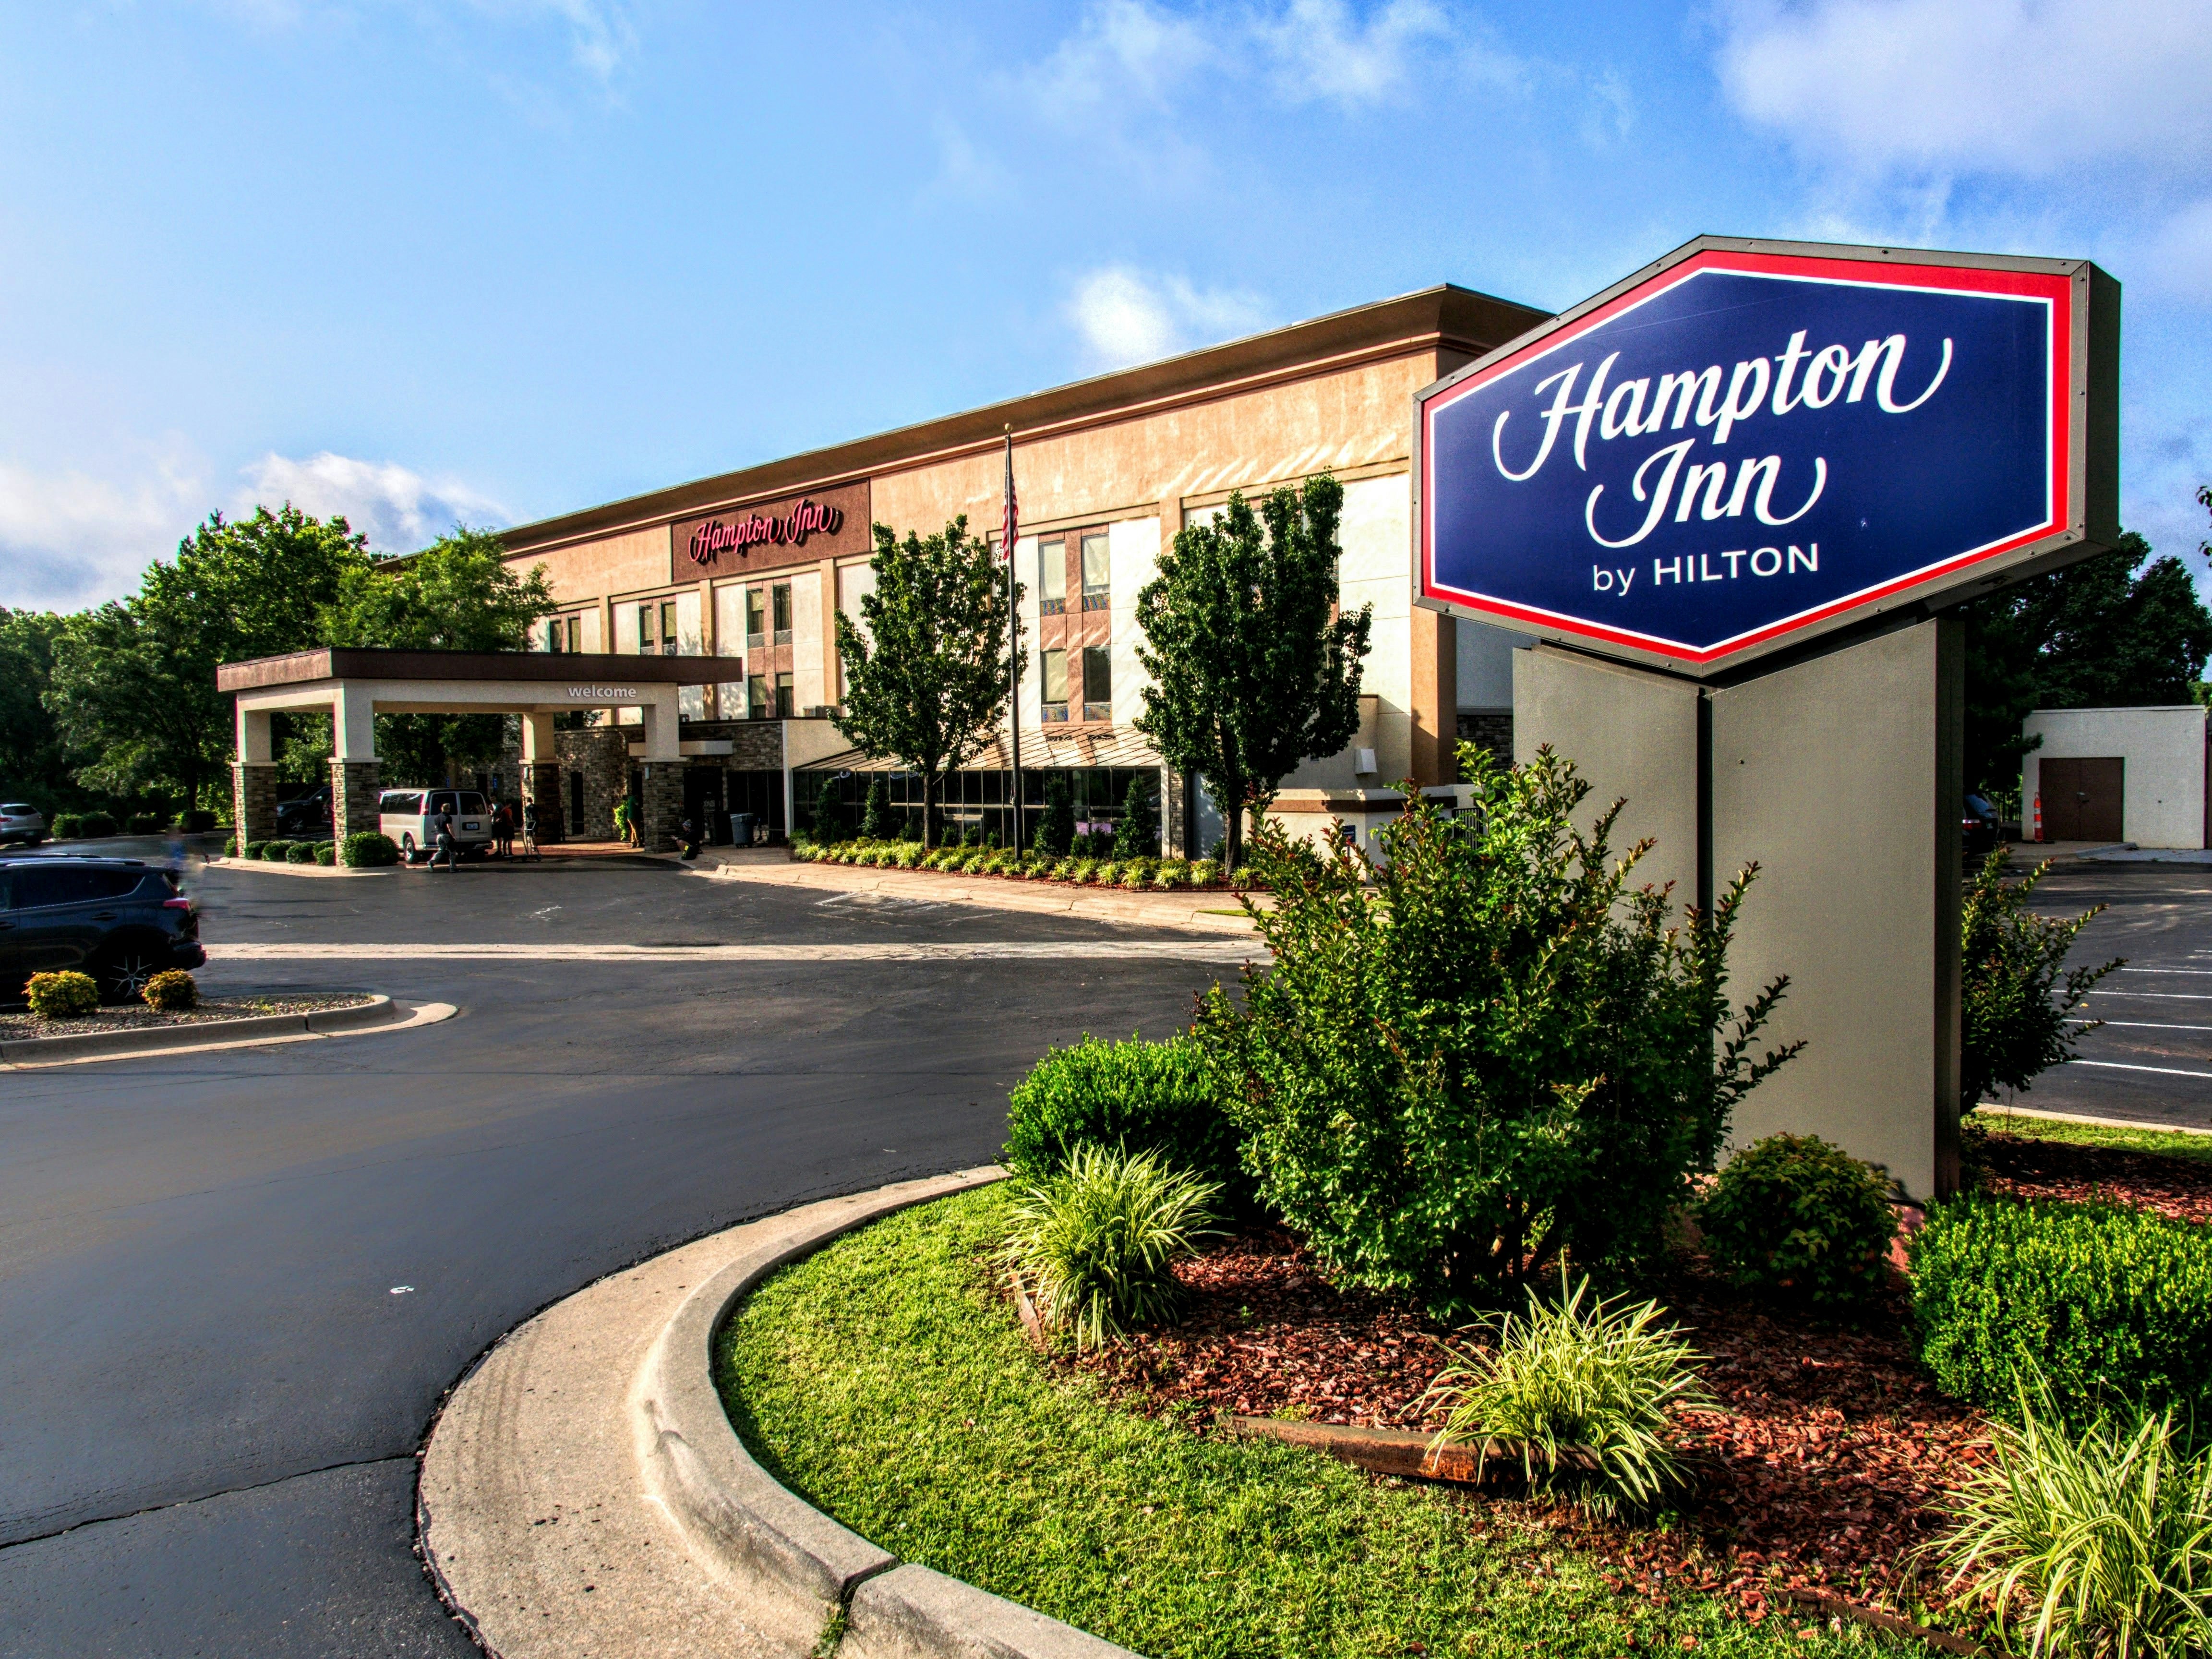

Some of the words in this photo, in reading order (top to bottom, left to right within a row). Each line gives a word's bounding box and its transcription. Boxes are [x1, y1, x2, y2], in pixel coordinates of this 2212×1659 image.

[1492, 329, 1952, 481] Hampton
[1585, 438, 1827, 548] Inn
[688, 514, 781, 562] Hampton
[785, 499, 833, 543] Inn
[1592, 564, 1636, 597] by
[1654, 542, 1819, 586] HILTON
[568, 685, 637, 698] welcome
